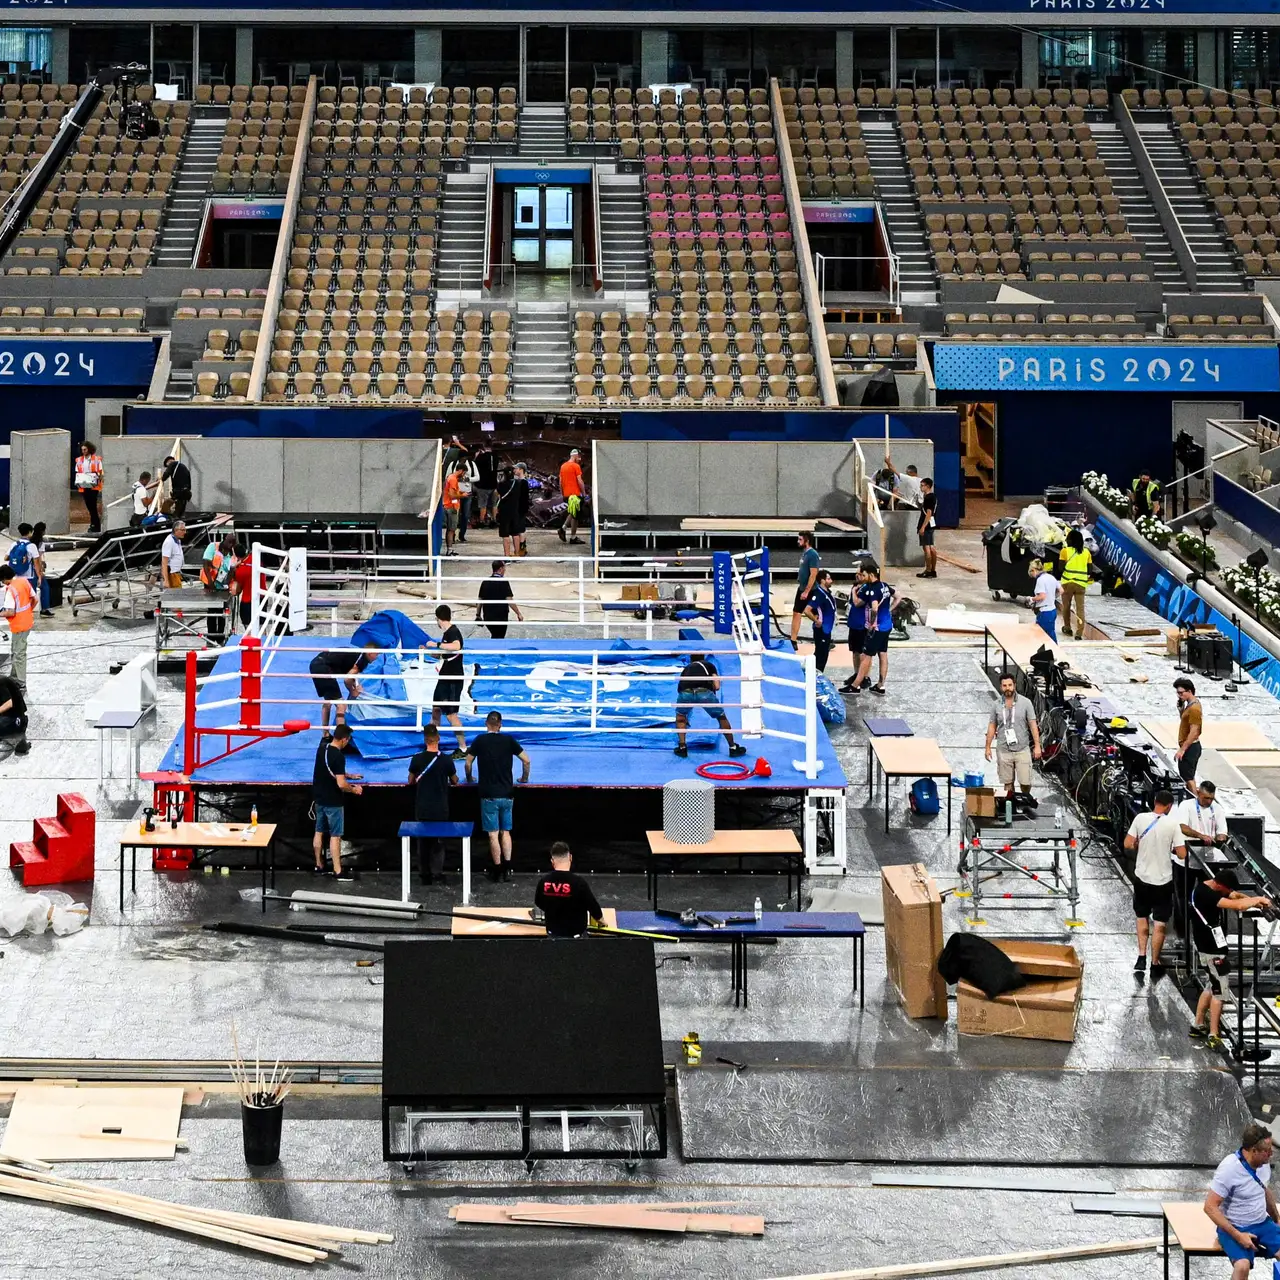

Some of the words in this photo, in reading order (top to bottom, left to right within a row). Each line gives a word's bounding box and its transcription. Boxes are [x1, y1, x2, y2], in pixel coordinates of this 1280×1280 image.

[998, 357, 1106, 382] PARIS
[1123, 358, 1220, 382] 2024
[1099, 534, 1122, 566] PARIS
[1119, 552, 1142, 586] 2024
[718, 594, 726, 624] PARIS
[543, 881, 572, 893] FVS
